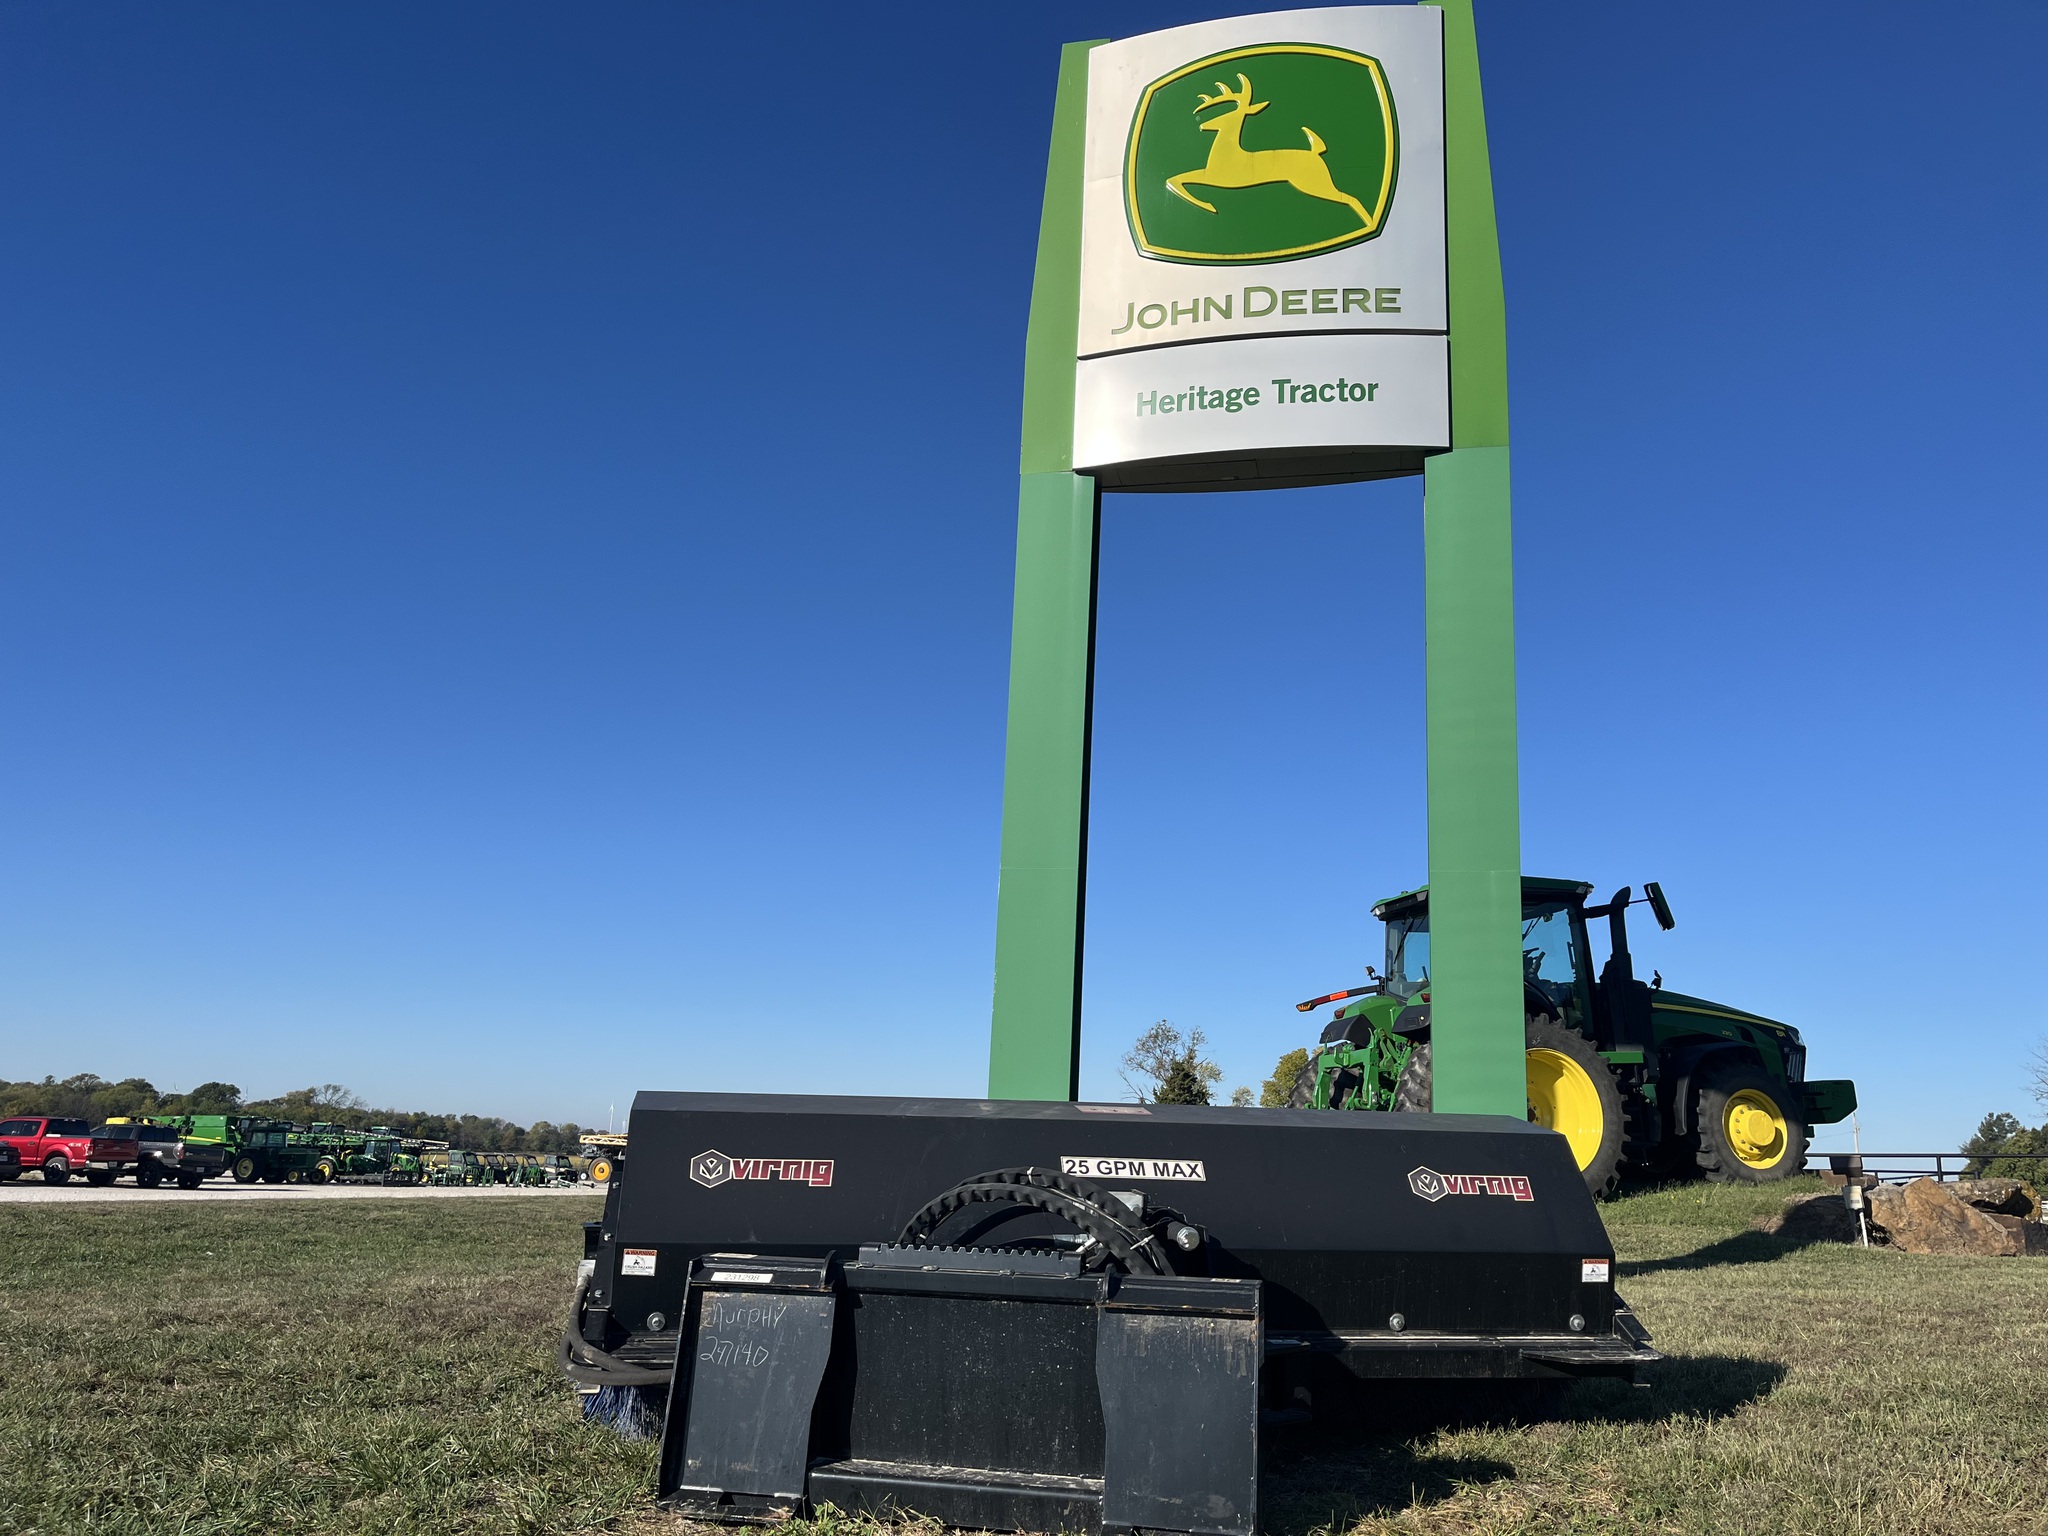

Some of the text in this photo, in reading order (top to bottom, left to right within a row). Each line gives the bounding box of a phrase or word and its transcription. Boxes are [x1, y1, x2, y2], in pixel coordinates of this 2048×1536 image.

[1111, 286, 1402, 335] JOHN DEERE
[1136, 377, 1379, 417] Heritage Tractor
[1064, 1159, 1202, 1178] 25 GPM MAX
[724, 1273, 761, 1281] 231298
